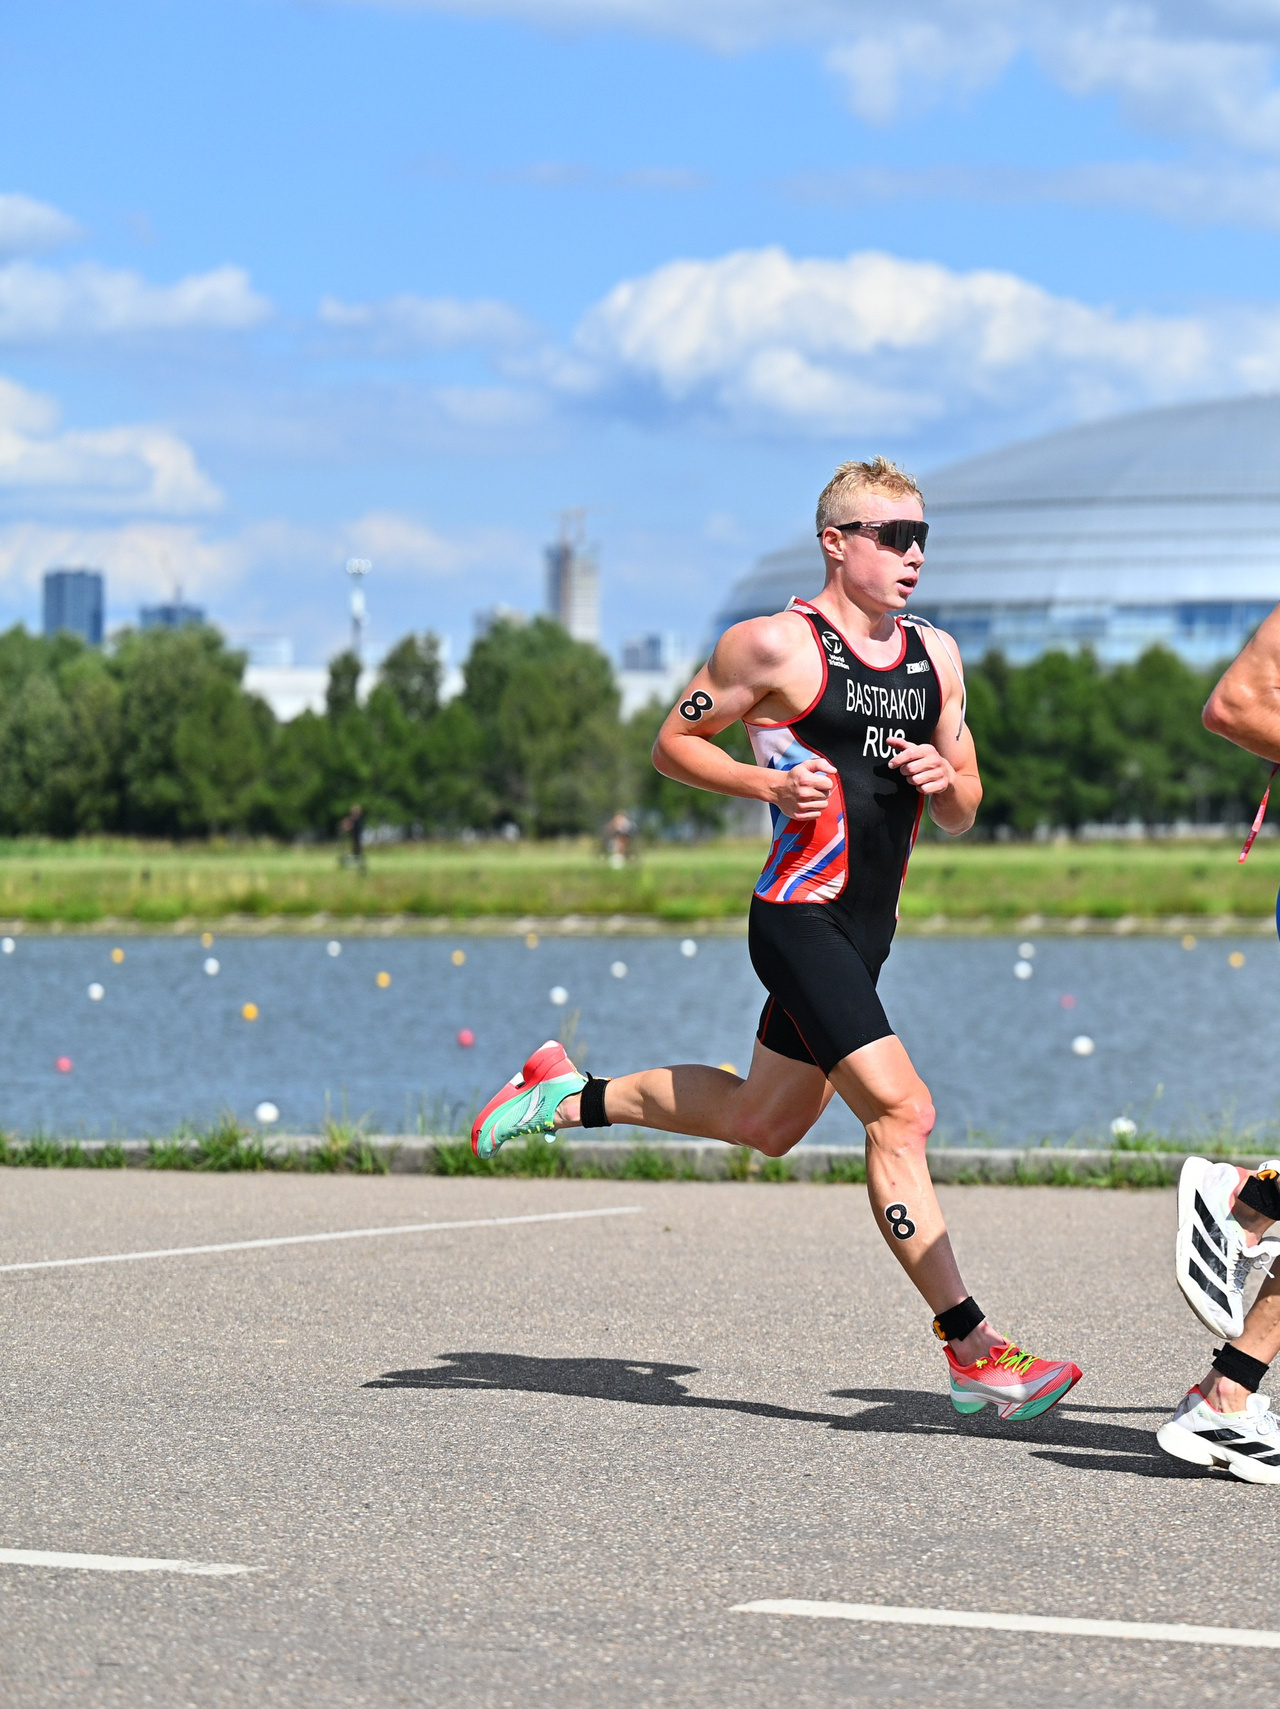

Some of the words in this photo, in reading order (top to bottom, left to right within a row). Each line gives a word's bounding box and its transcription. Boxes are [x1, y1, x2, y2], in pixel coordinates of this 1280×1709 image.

[678, 689, 714, 722] 8
[846, 678, 926, 721] BASTRAKOV
[884, 1201, 916, 1241] 8
